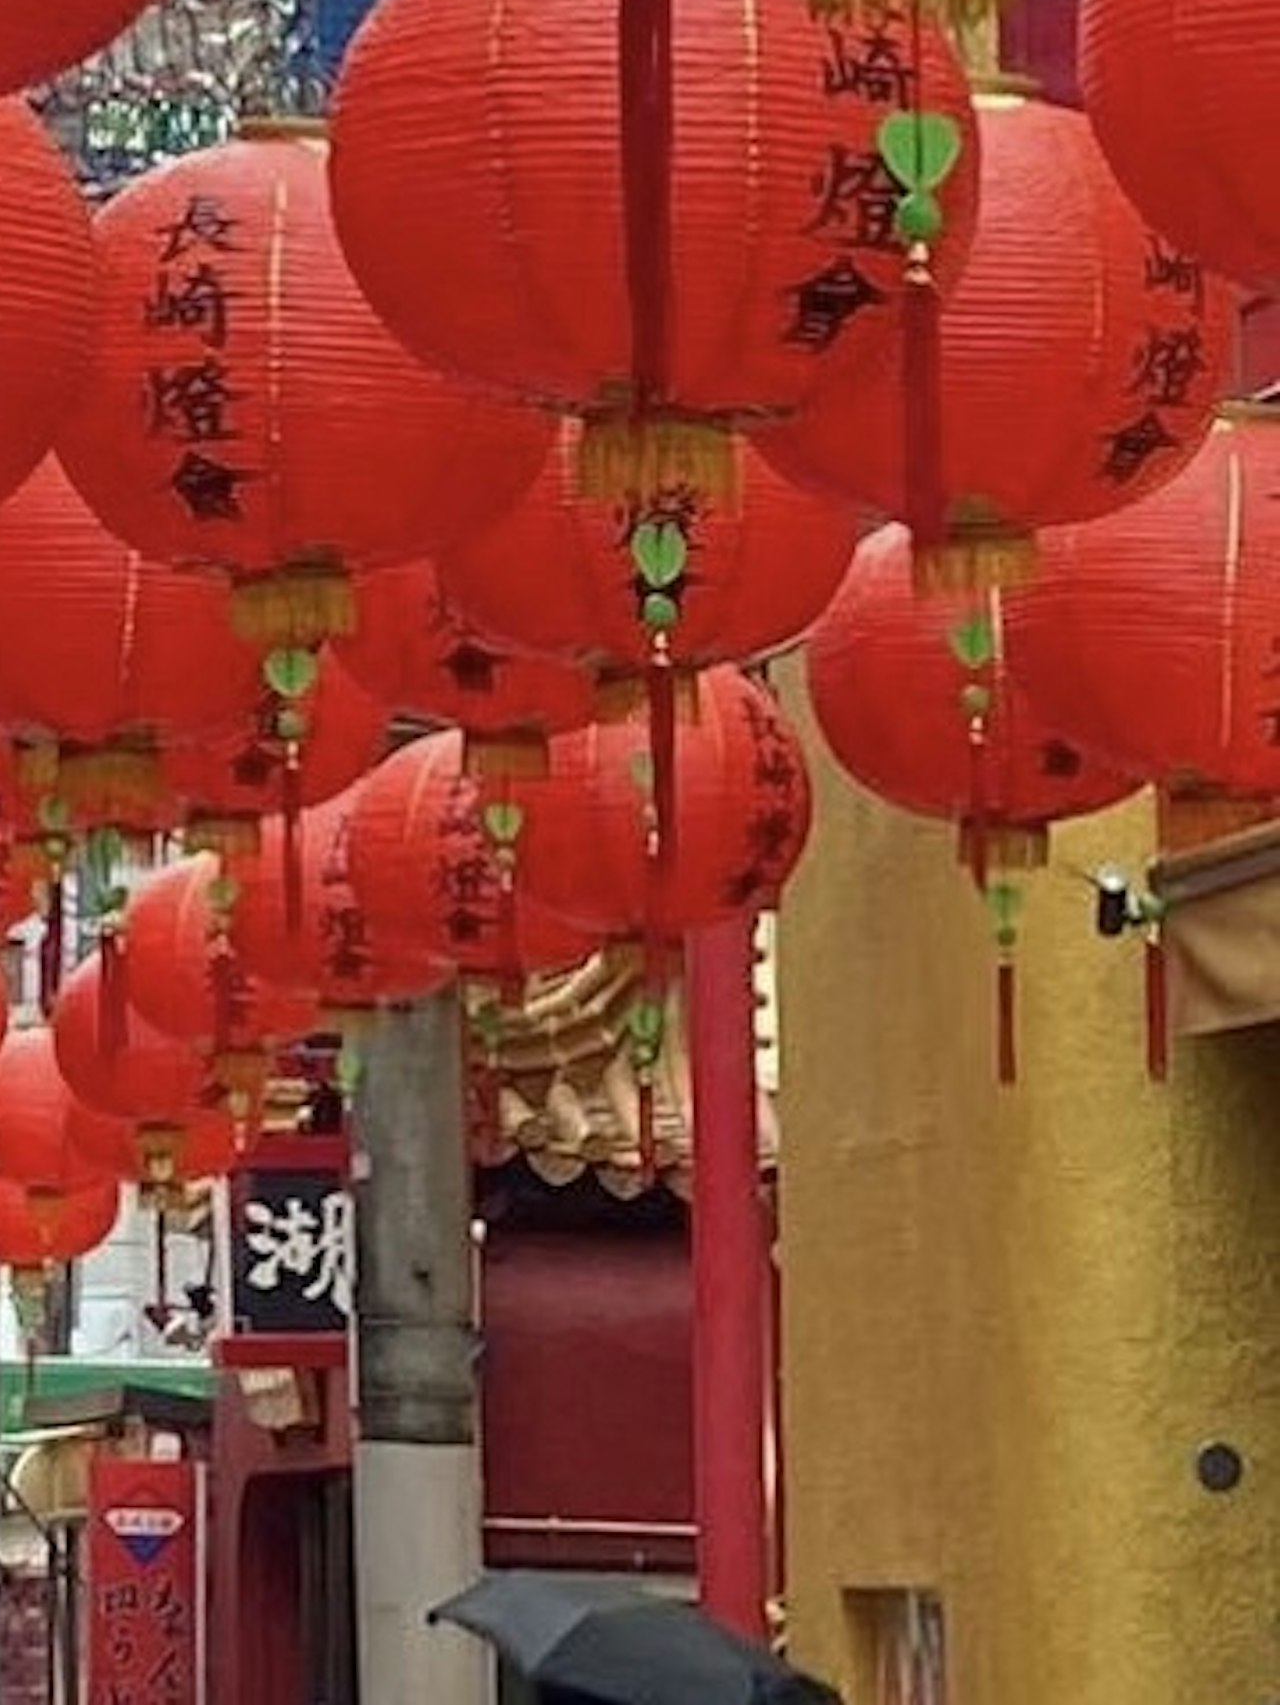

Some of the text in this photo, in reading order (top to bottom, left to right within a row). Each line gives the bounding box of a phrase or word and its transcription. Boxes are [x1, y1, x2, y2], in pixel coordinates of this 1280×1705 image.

[783, 10, 918, 354] 崎燈會
[142, 196, 272, 520] 長崎燈會
[244, 1190, 356, 1316] 湖
